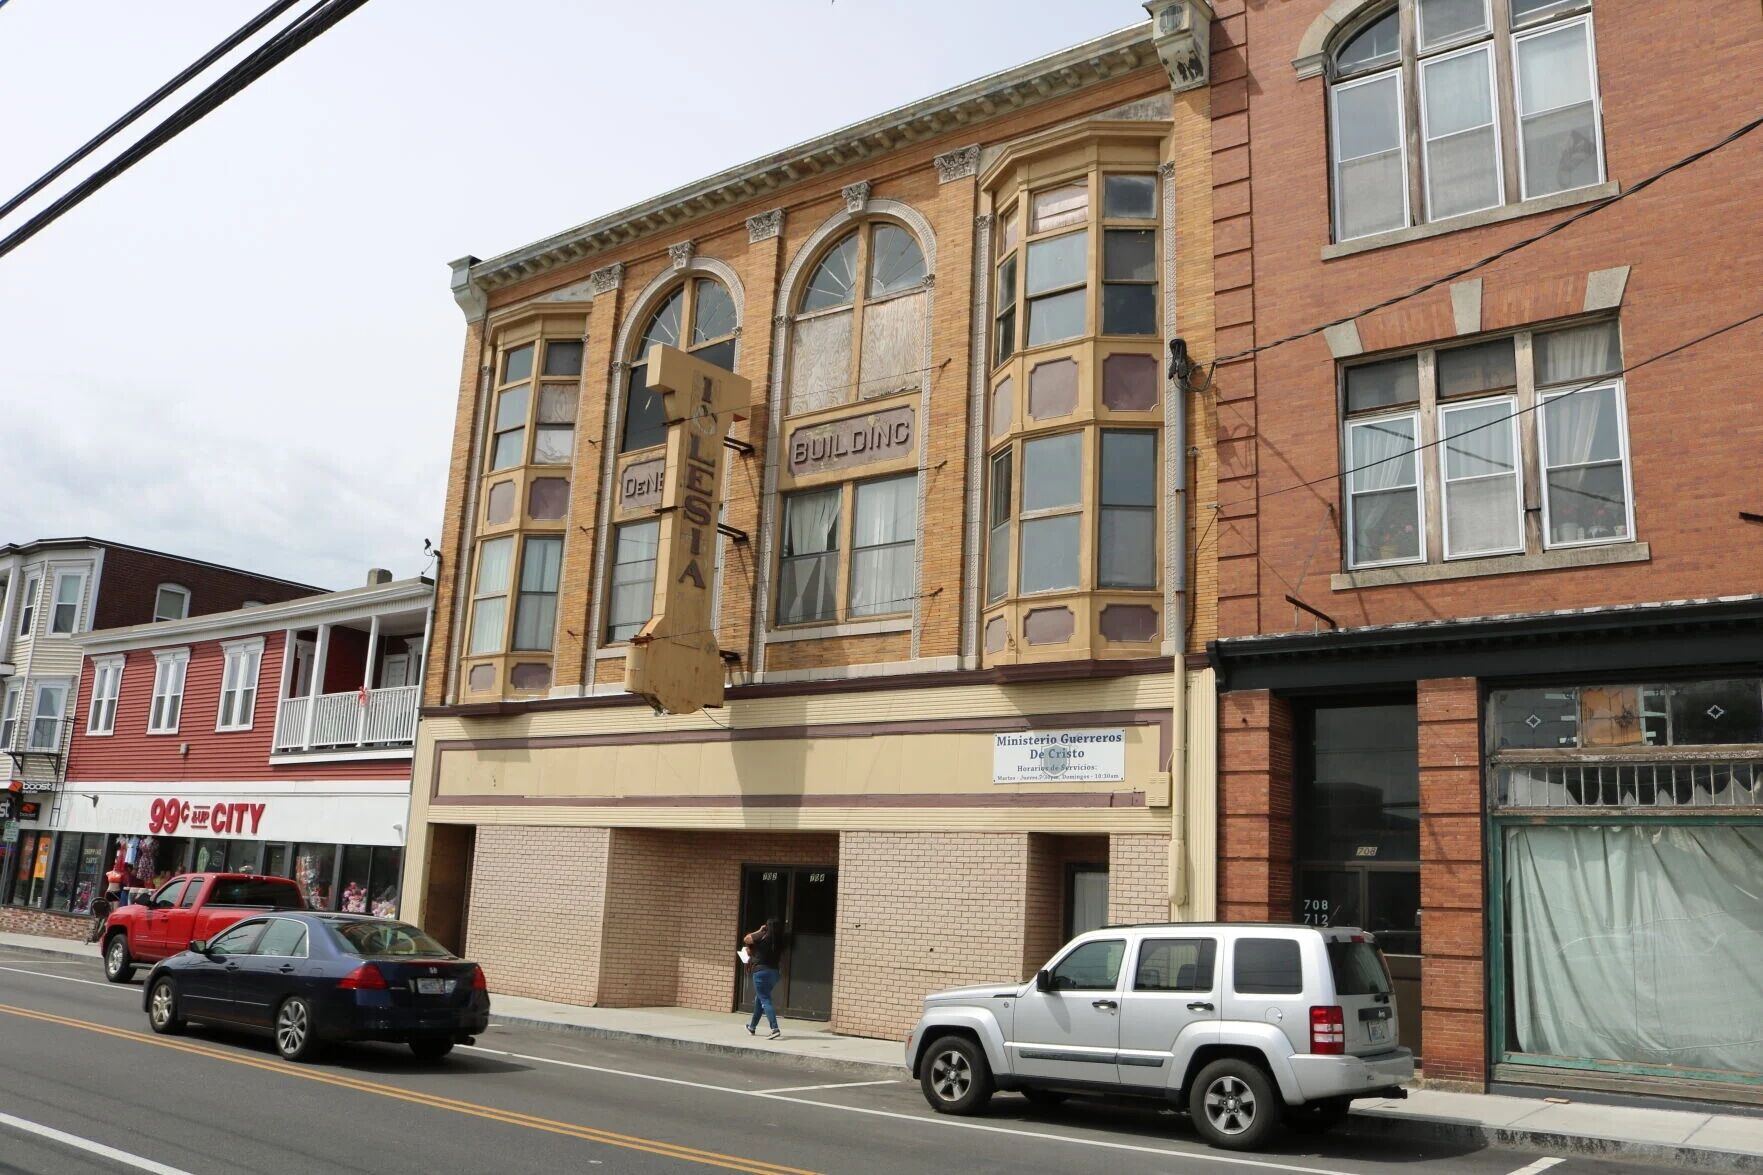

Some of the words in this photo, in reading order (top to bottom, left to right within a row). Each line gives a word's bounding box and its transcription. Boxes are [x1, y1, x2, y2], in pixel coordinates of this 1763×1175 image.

[794, 421, 909, 464] BUILDING
[997, 734, 1057, 746] Ministerio
[1061, 733, 1122, 744] Guerreros
[1030, 749, 1045, 759] De
[1048, 748, 1085, 759] Cristo
[23, 782, 52, 790] boost
[211, 803, 266, 834] CITY
[1357, 847, 1377, 856] 708
[1304, 899, 1328, 910] 708
[1304, 914, 1328, 925] 712
